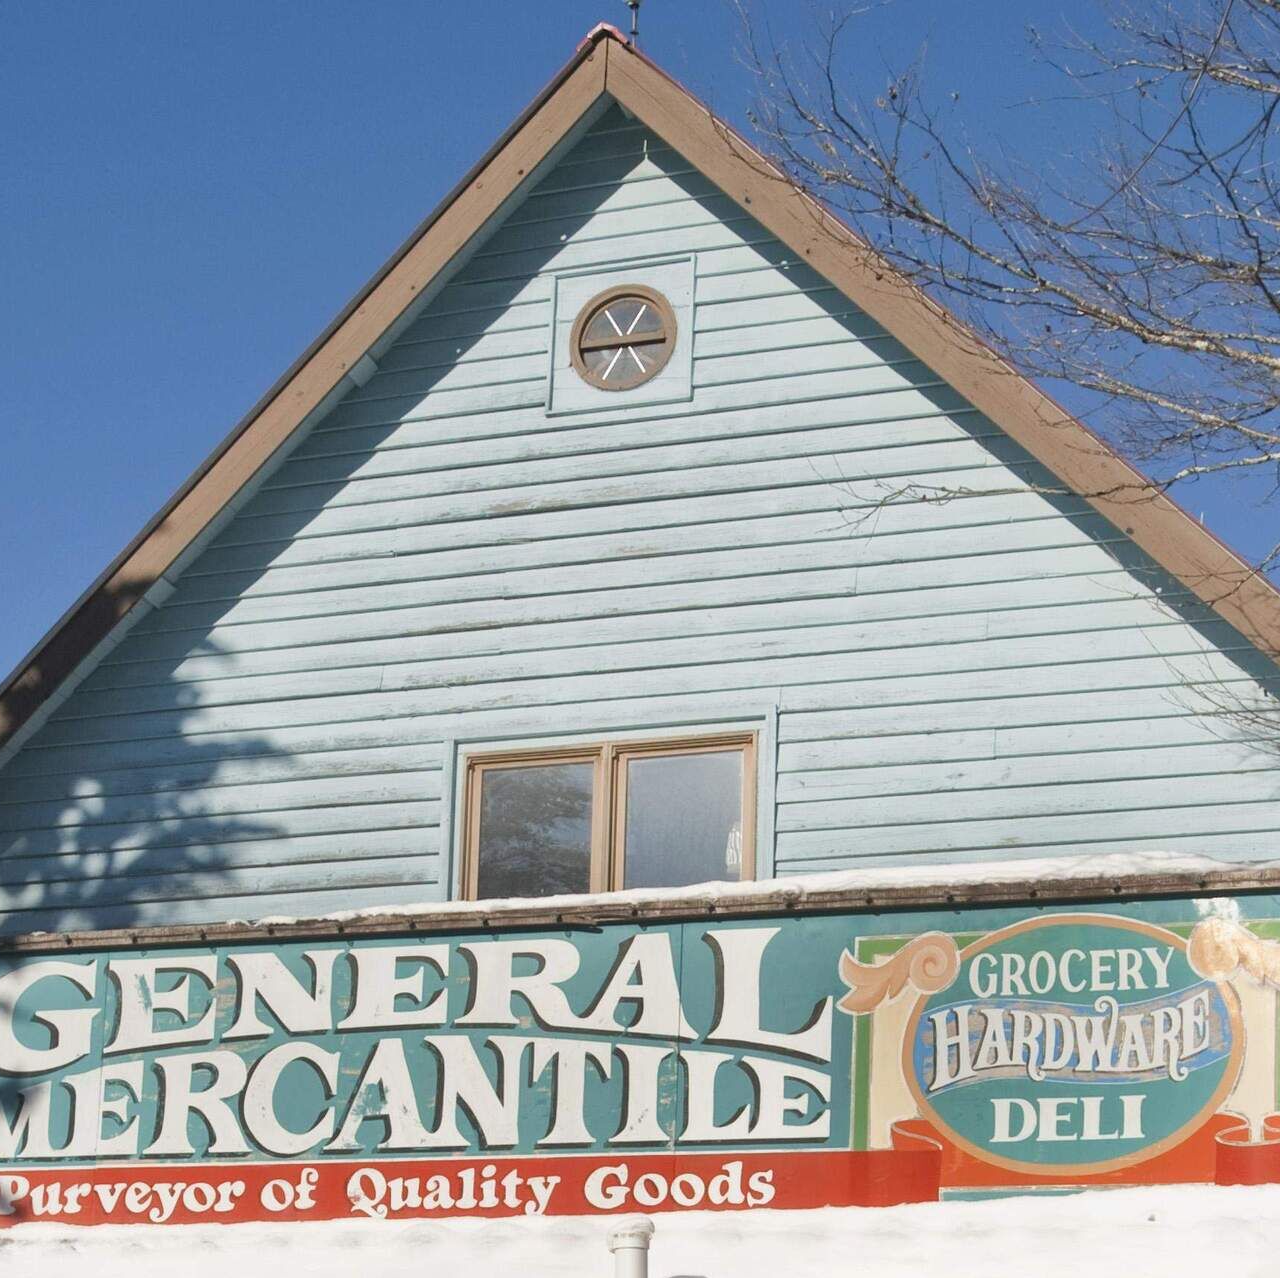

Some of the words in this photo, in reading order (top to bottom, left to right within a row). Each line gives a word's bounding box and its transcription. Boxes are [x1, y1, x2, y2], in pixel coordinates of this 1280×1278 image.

[968, 946, 1175, 998] GROCERY
[927, 988, 1210, 1092] HARDWARE
[989, 1095, 1148, 1143] DELI
[260, 1167, 319, 1213] of
[346, 1164, 561, 1220] Quality
[584, 1160, 776, 1210] Goods
